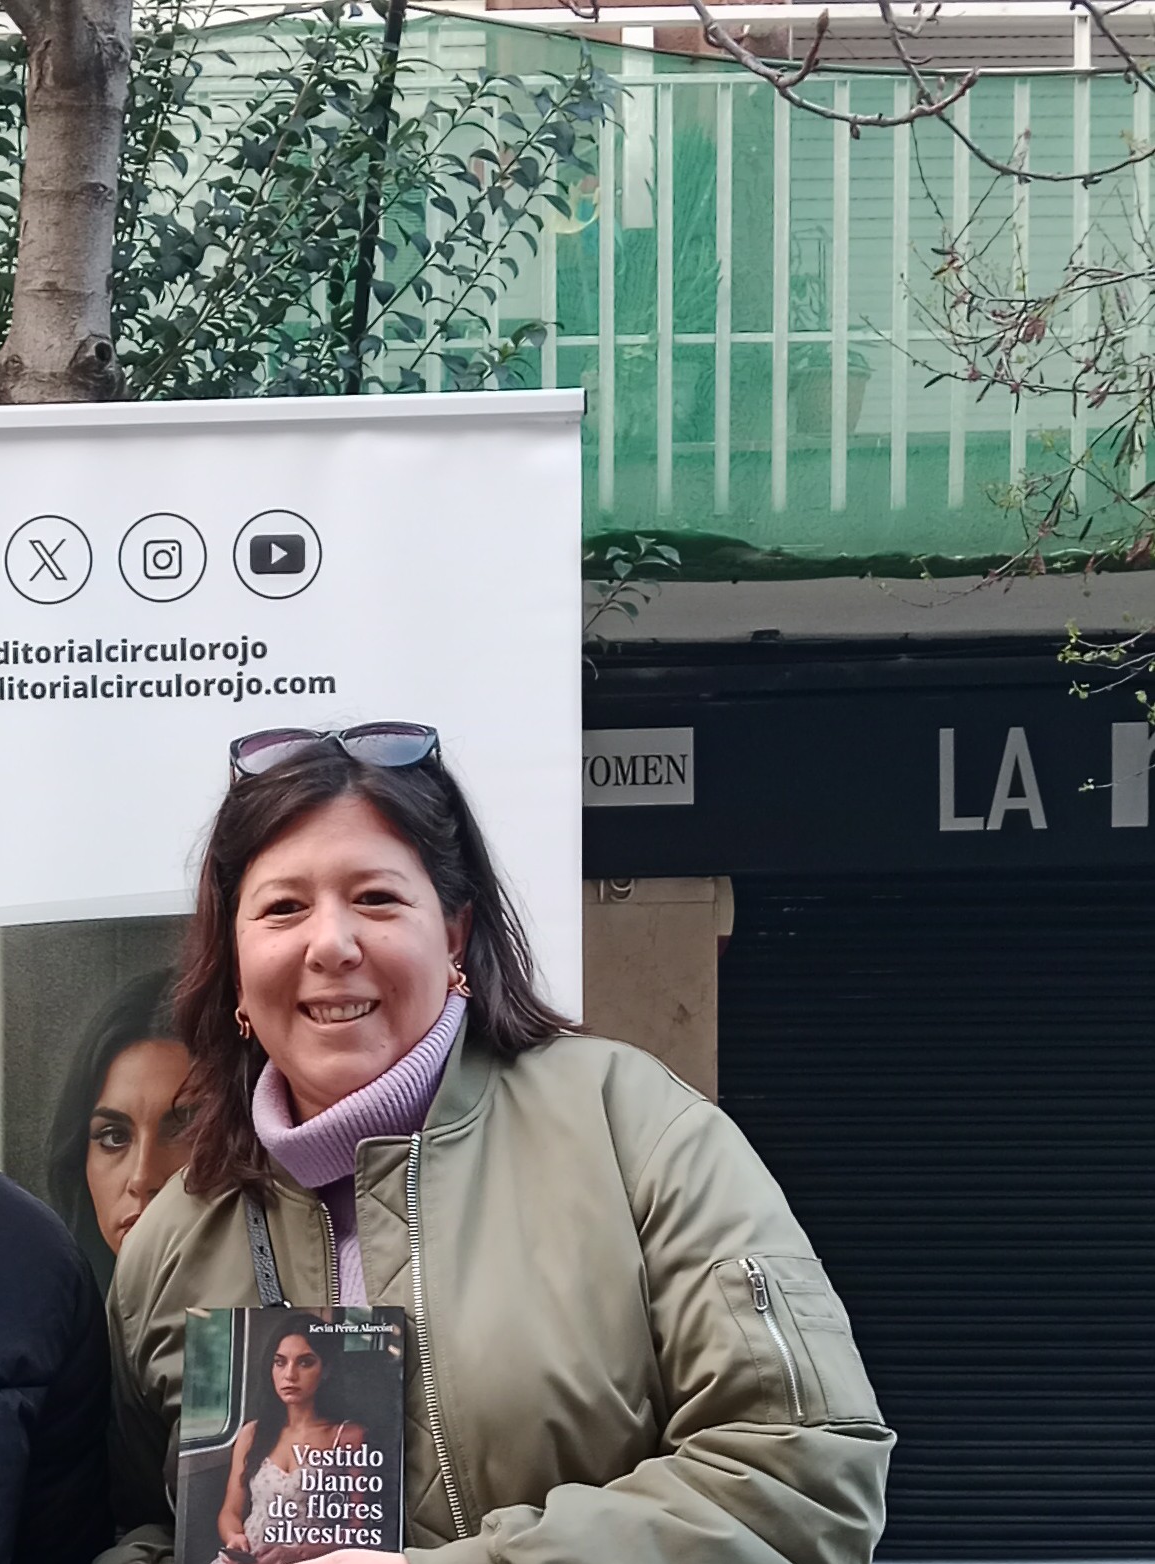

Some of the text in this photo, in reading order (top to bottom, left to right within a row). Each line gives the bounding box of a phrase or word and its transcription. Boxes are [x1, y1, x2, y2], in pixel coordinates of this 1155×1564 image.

[940, 727, 1047, 831] LA
[292, 1444, 384, 1468] Vestido
[301, 1469, 383, 1493] blanco
[268, 1494, 384, 1520] de flores
[264, 1520, 382, 1545] silvestres
